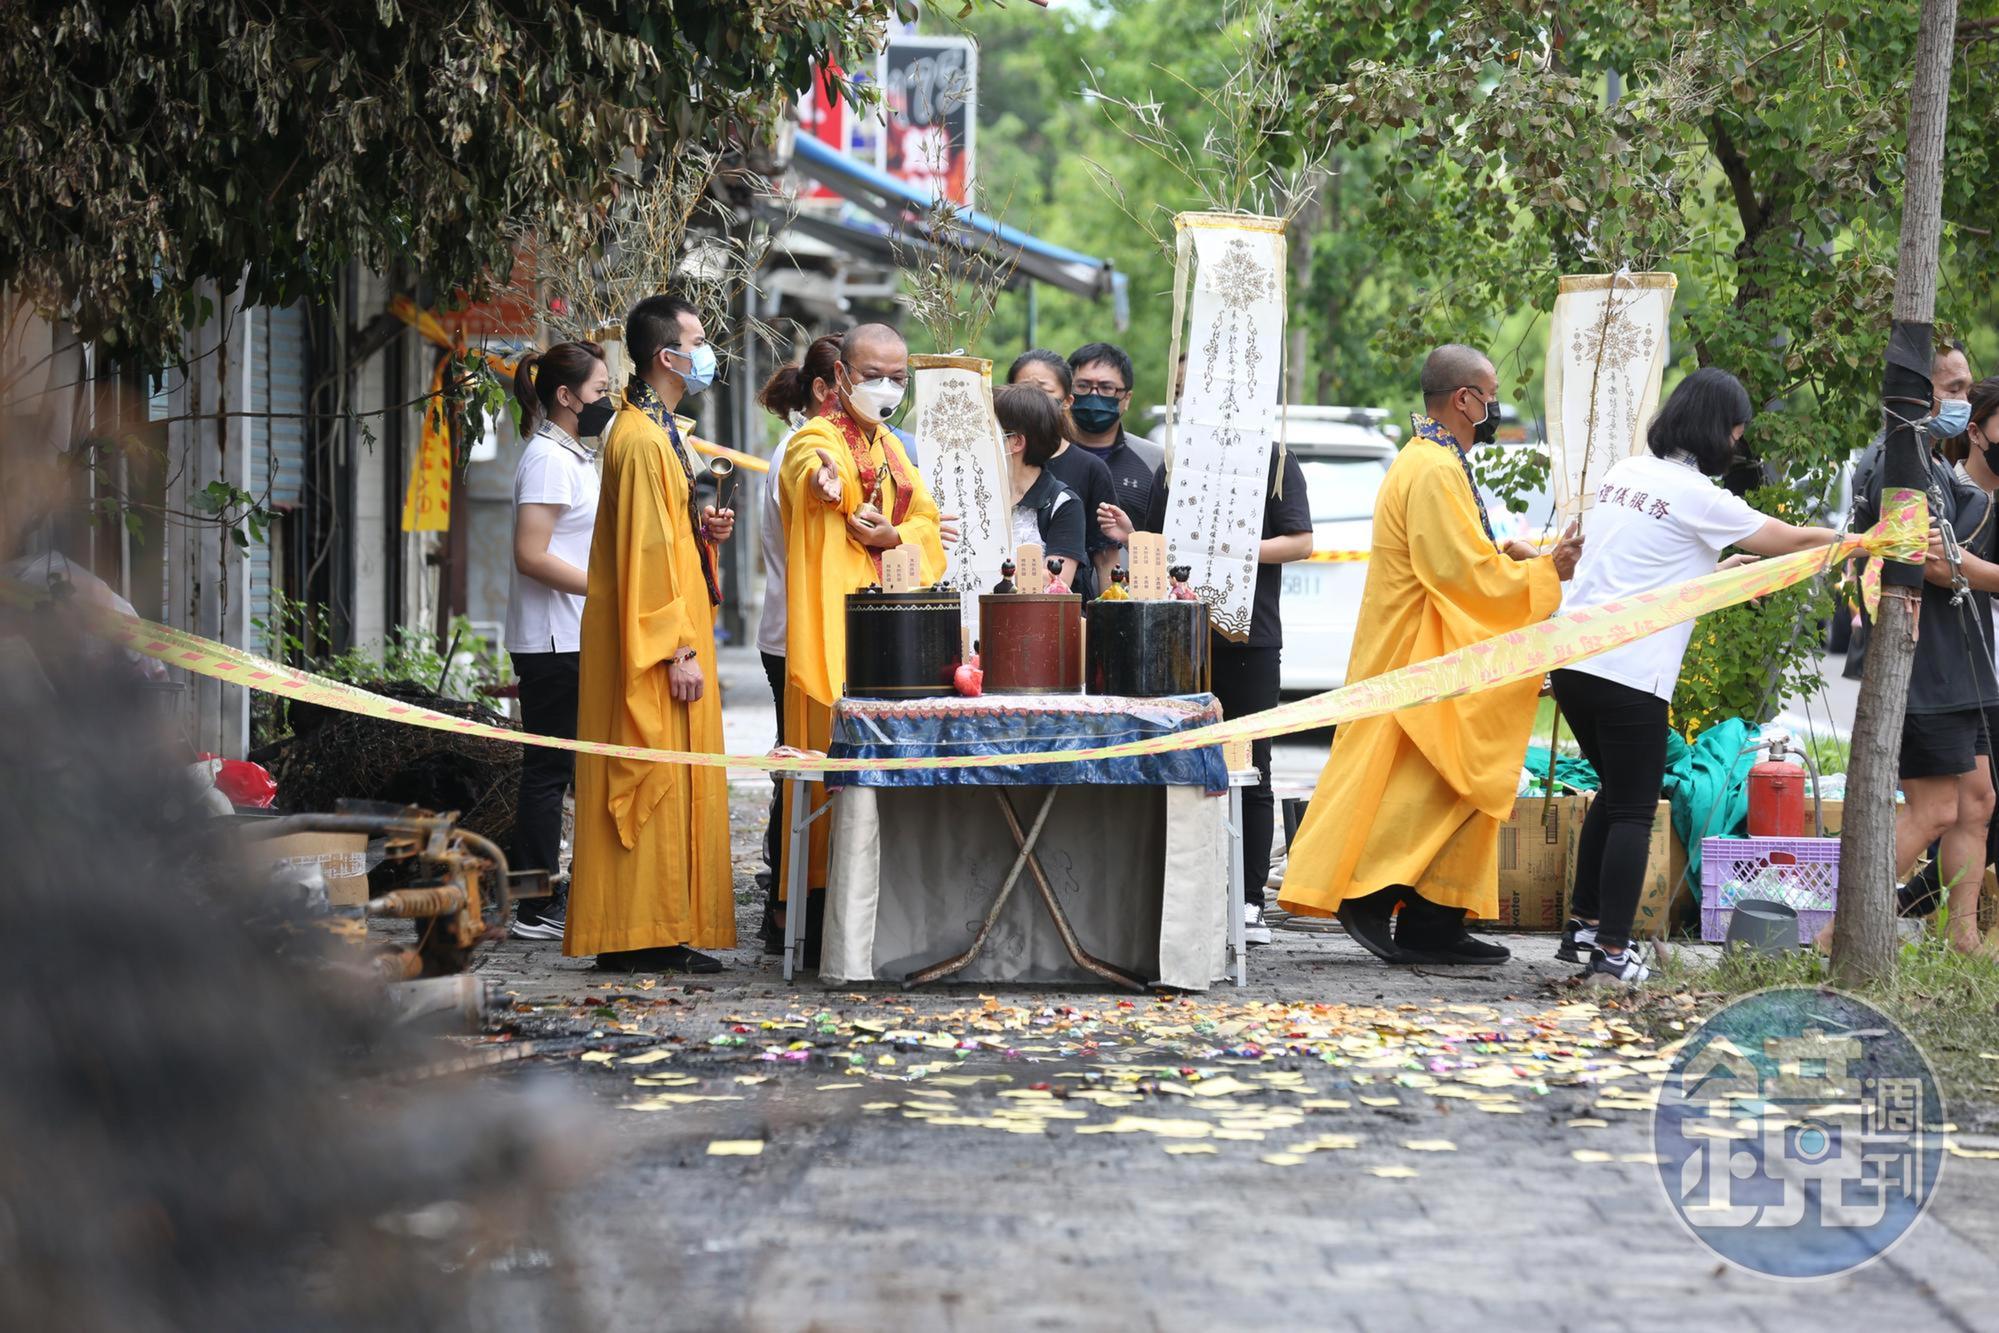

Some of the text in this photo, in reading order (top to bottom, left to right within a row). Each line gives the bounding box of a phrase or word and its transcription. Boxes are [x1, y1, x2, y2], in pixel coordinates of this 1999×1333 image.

[1599, 483, 1671, 520] 禮儀服務
[1511, 890, 1521, 928] water
